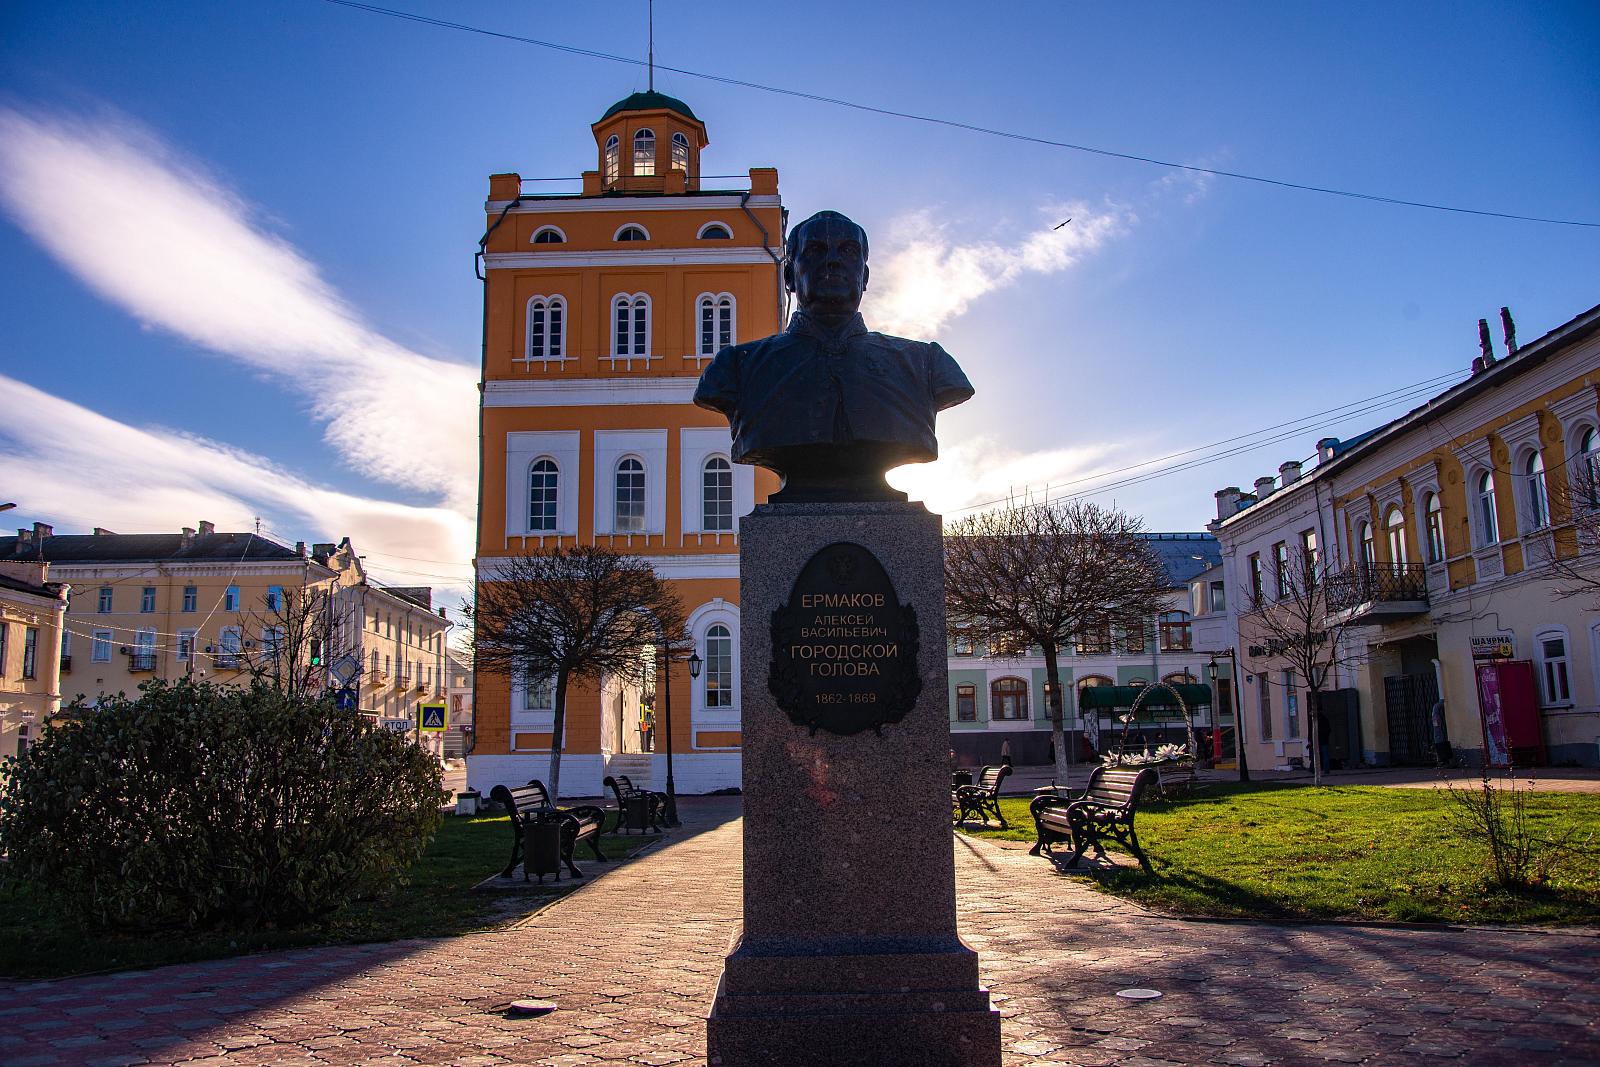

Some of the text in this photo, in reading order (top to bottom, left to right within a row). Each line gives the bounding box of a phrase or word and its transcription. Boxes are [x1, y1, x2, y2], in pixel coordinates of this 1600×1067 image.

[802, 594, 885, 608] ЕРМАКОВ
[814, 614, 874, 625] АЛЕКСЕЙ
[801, 627, 887, 638] ВАСИЛЬЕВИЧ
[1472, 637, 1510, 645] ШАУРМА
[791, 642, 897, 660] ГОРОДСКОЙ
[810, 662, 880, 676] ГОЛОВА
[815, 694, 876, 704] 1862-1869
